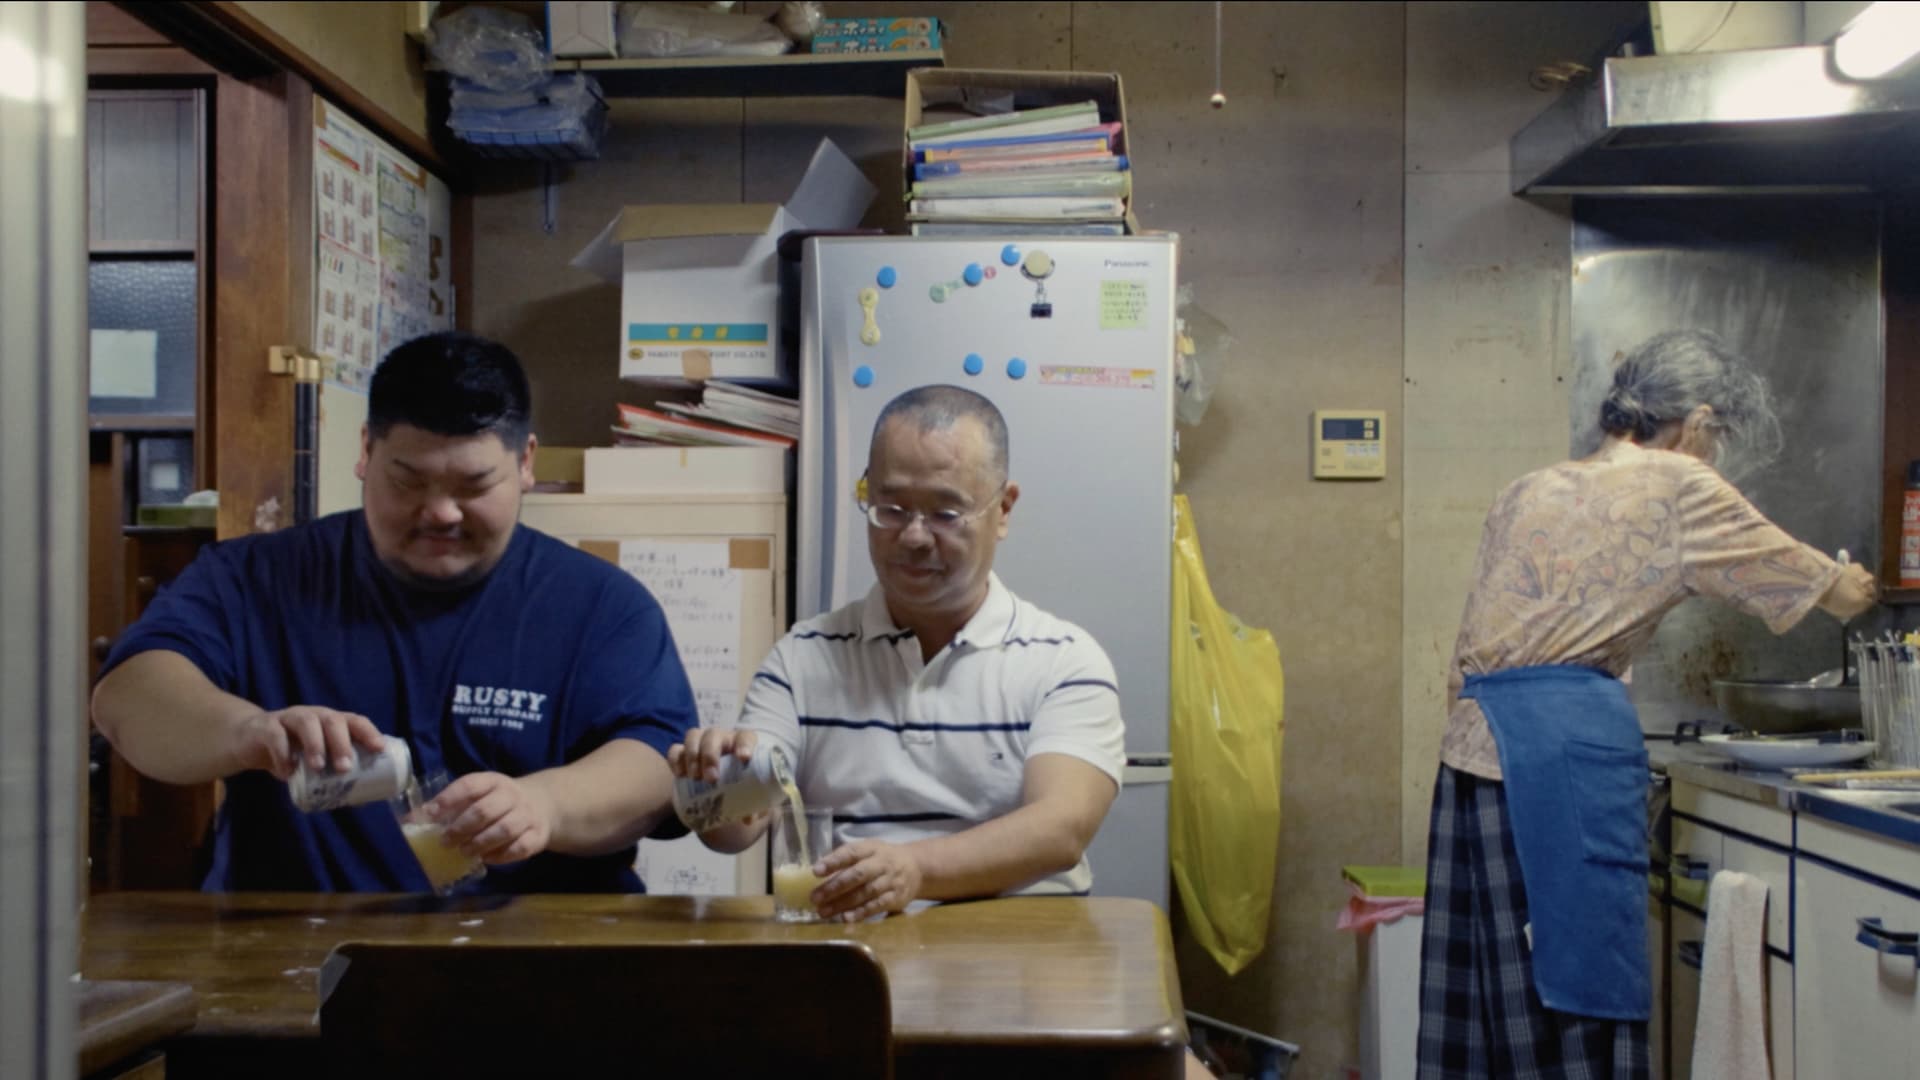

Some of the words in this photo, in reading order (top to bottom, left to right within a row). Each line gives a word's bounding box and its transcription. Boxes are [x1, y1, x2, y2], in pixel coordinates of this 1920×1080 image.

[454, 685, 547, 712] RUSTY
[452, 704, 490, 715] SUPPLY
[493, 706, 542, 722] COMPANY
